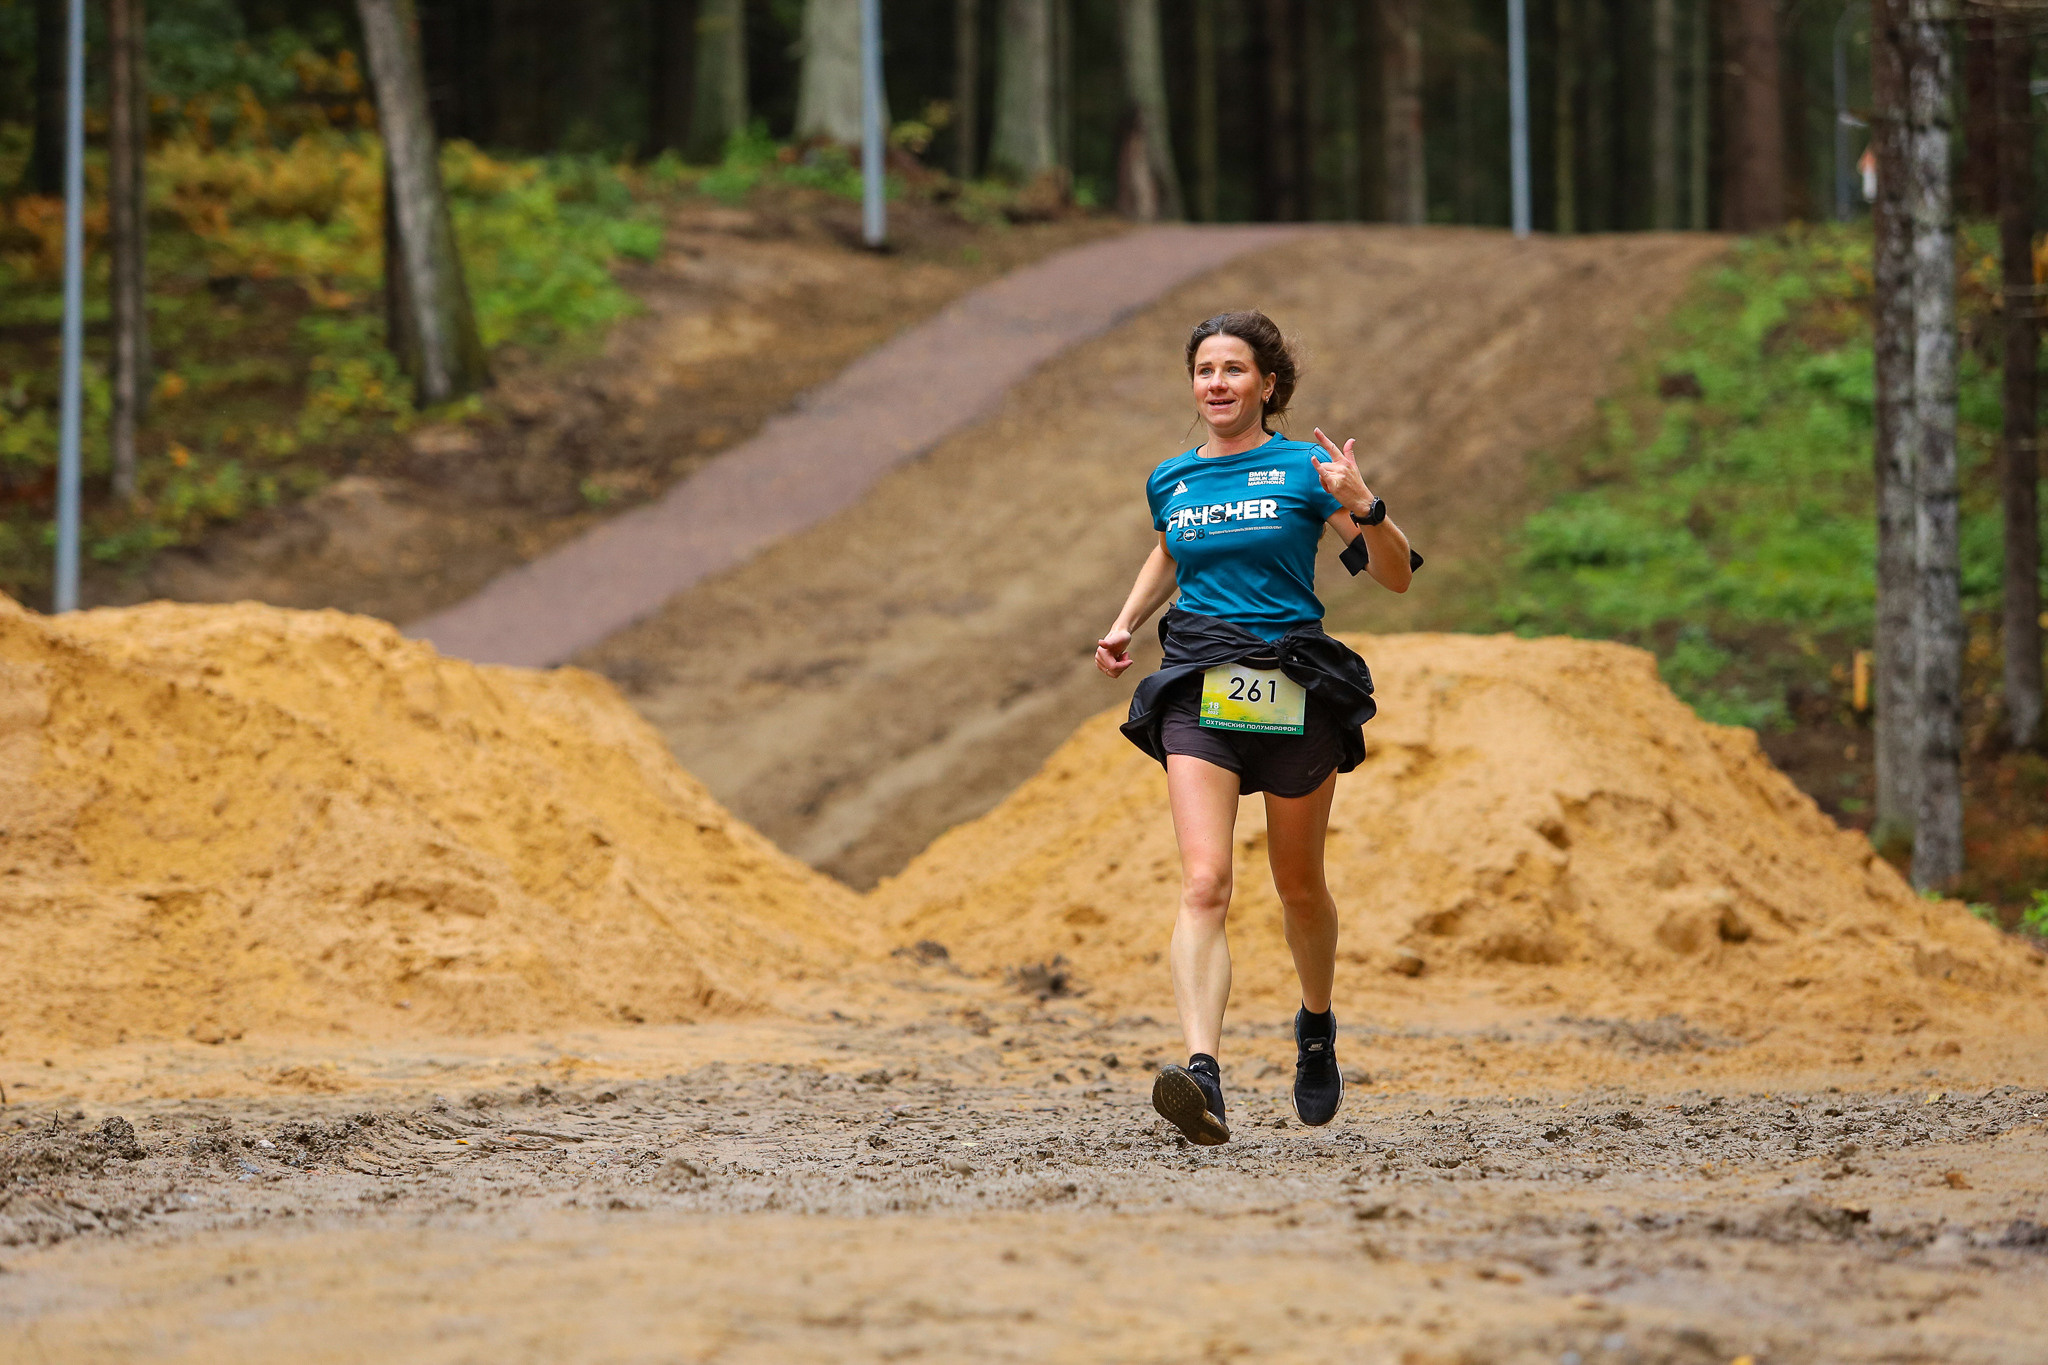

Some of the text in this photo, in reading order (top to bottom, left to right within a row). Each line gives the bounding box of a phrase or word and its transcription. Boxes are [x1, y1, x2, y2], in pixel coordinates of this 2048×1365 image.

[1167, 499, 1279, 532] FINISHER
[1228, 677, 1276, 703] 261
[1208, 701, 1219, 709] 18
[1206, 720, 1297, 732] ОХТИНСКИЙ ПОЛУМАРАФОН
